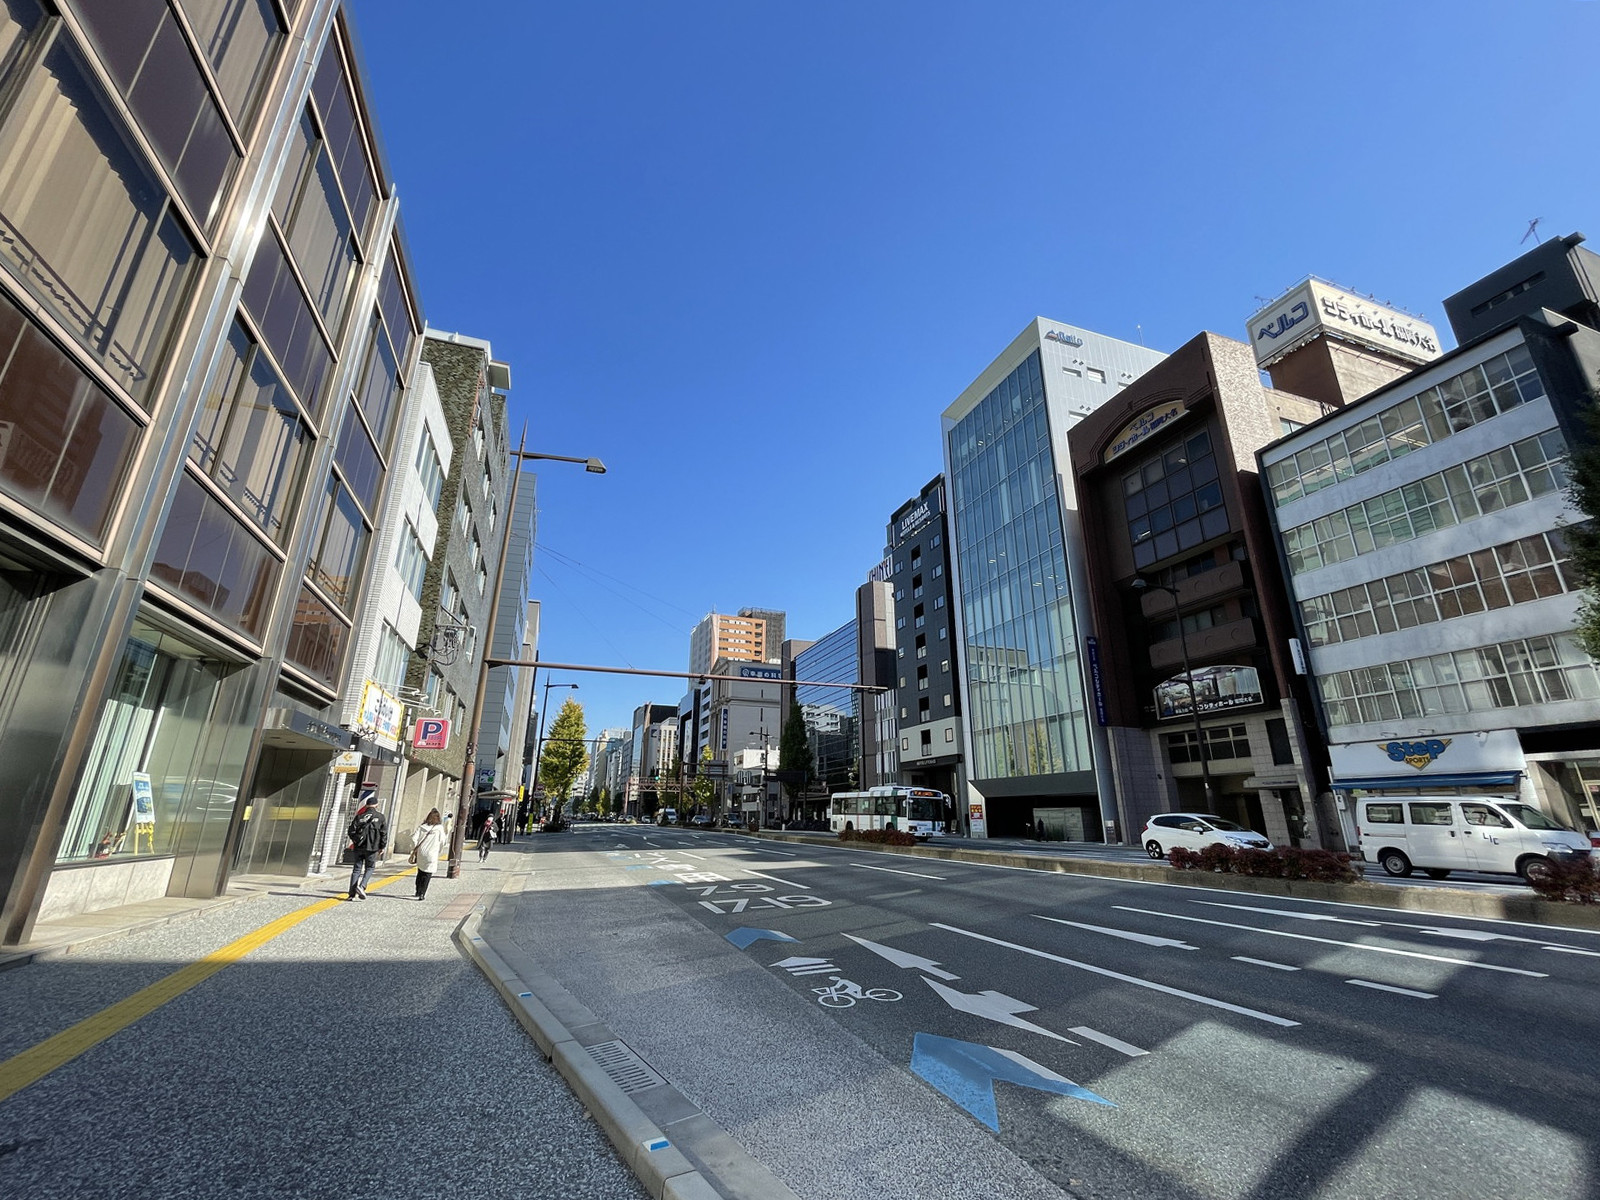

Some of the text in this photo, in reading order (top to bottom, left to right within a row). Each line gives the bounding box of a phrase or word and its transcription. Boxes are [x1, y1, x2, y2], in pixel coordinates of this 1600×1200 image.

[1257, 301, 1309, 340] ベルコ
[1129, 411, 1155, 431] ベルコ
[902, 502, 928, 529] LIVEMAX
[421, 721, 443, 741] P
[1386, 739, 1446, 762] Step
[686, 883, 775, 896] 7-9
[698, 894, 833, 914] 17-19
